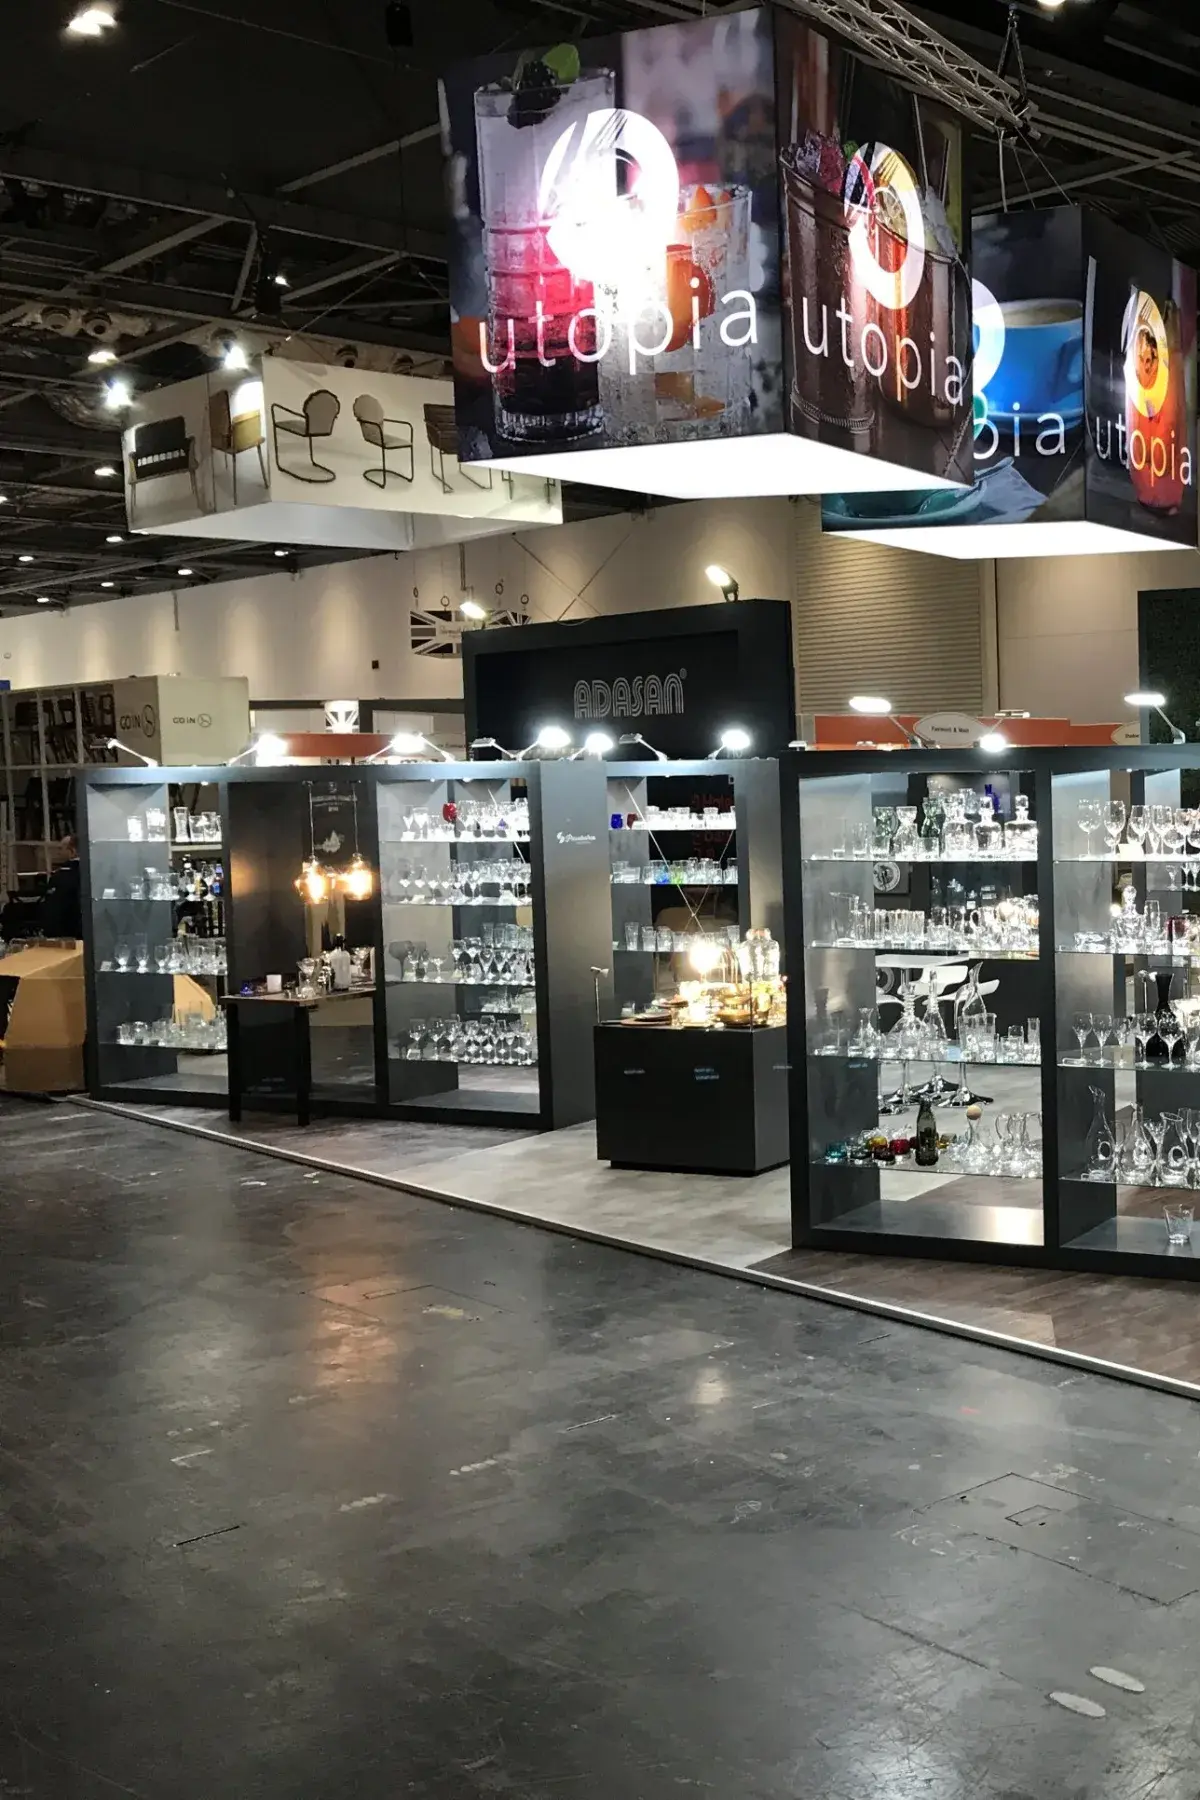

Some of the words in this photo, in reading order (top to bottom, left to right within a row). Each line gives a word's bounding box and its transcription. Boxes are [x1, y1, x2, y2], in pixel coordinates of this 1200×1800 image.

[479, 277, 758, 375] utopia
[803, 297, 963, 406] utopia
[973, 402, 1066, 460] pia
[1096, 413, 1192, 486] utopia
